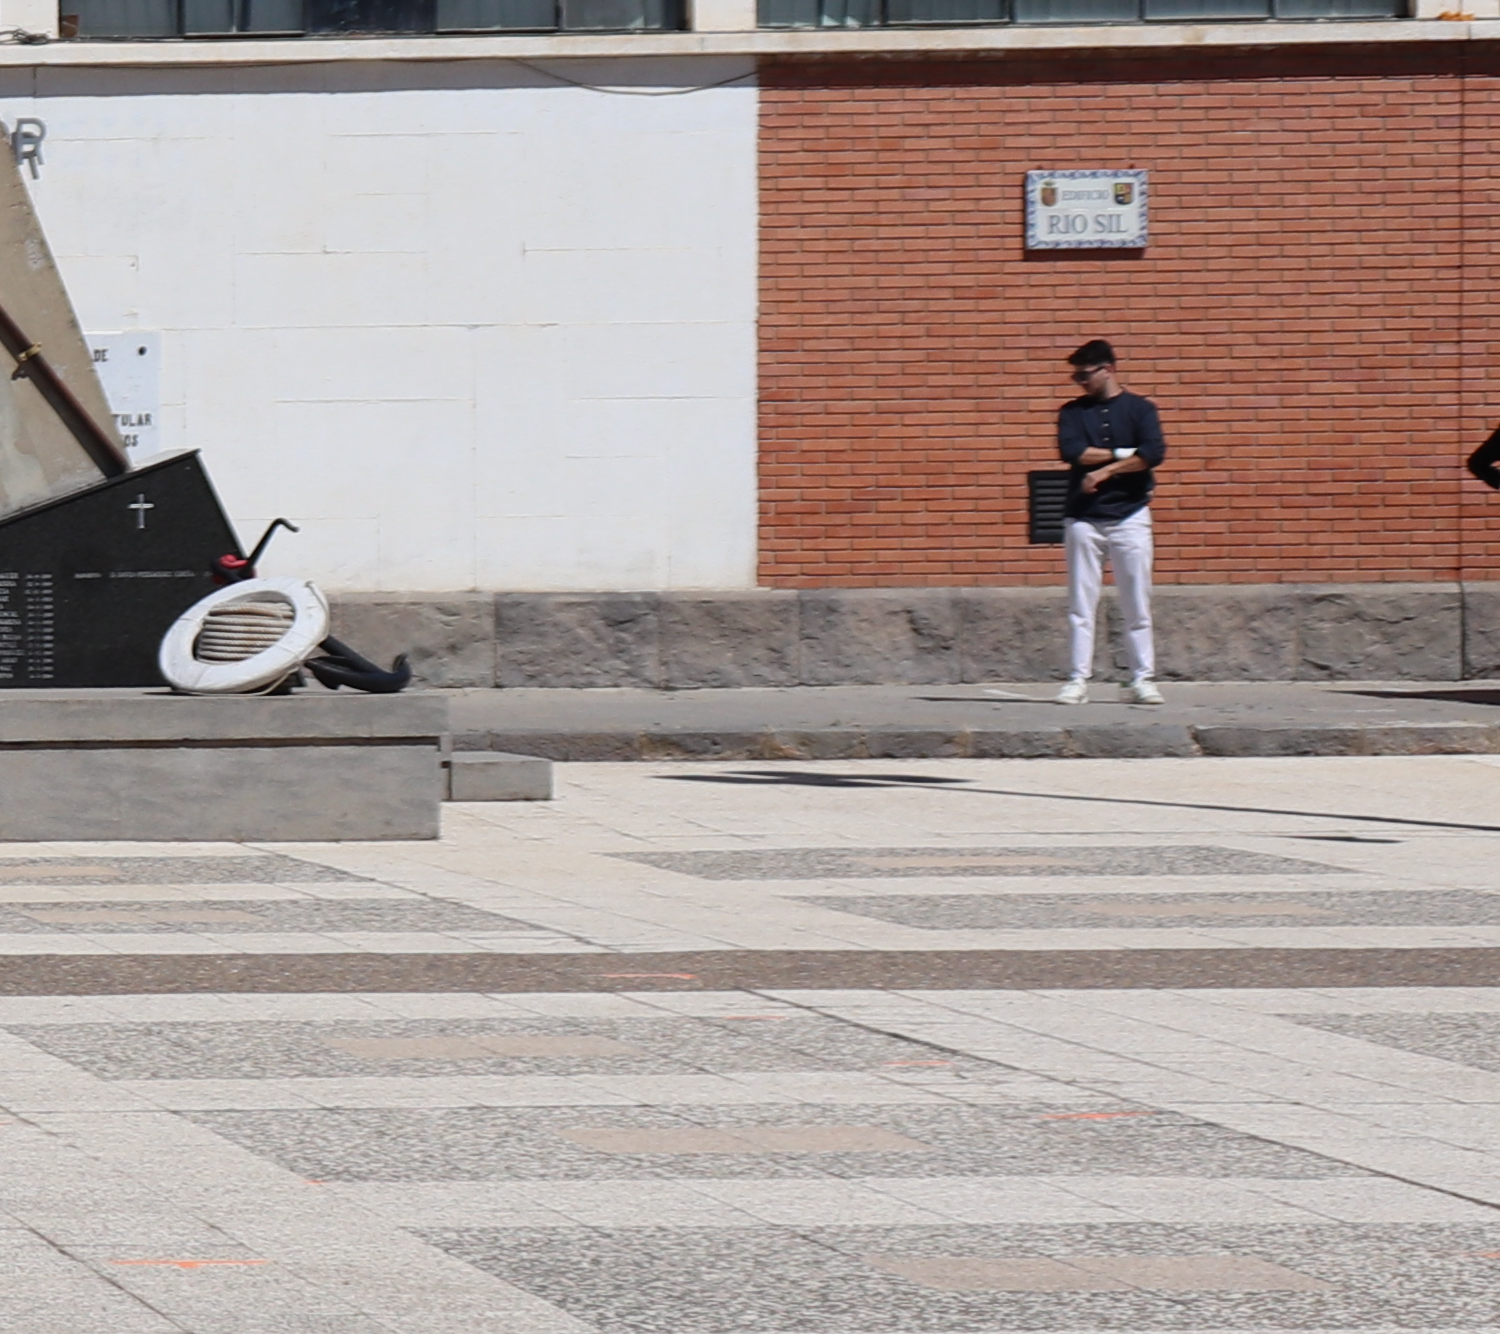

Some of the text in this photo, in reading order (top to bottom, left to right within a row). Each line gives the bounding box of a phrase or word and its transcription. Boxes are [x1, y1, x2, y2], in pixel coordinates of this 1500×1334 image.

[1061, 189, 1110, 201] EDIFICIO
[1048, 213, 1129, 235] RIO SIL
